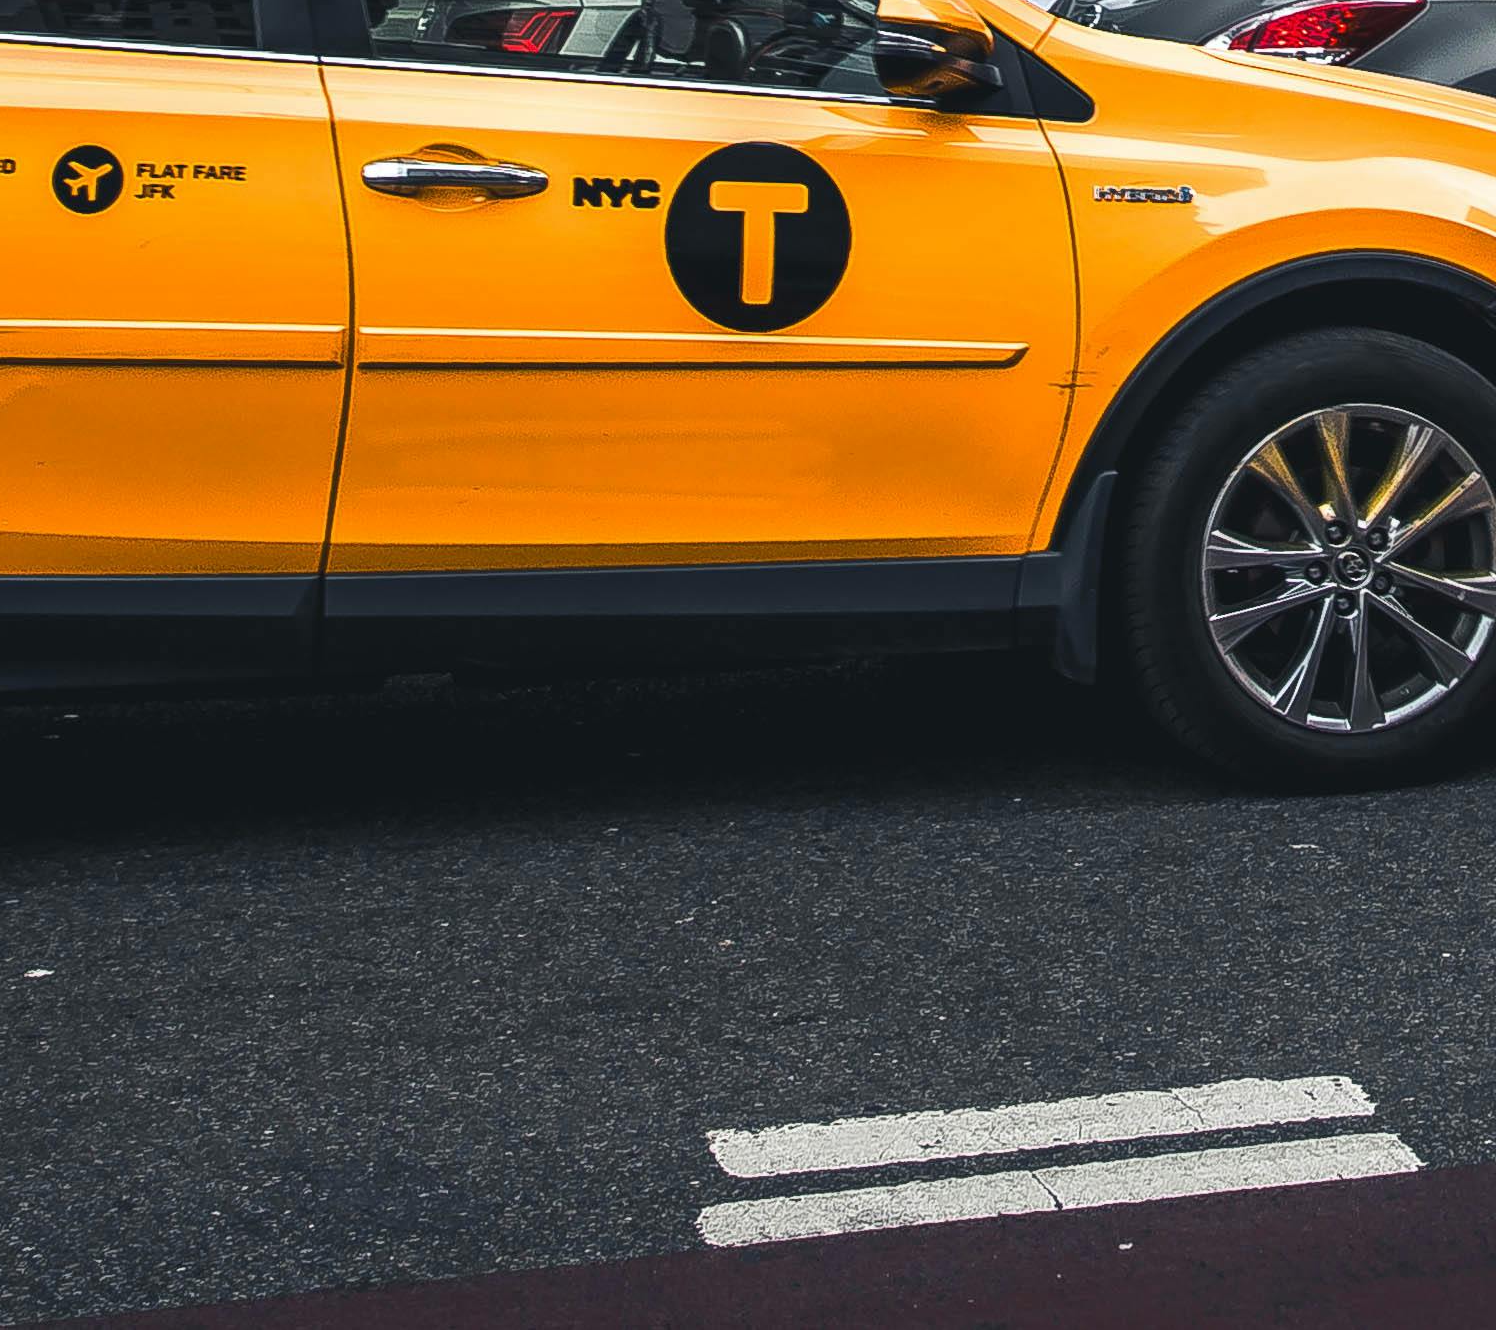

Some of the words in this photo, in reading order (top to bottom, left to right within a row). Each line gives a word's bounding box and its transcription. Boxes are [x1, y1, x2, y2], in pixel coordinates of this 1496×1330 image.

[135, 163, 189, 179] FLAT
[192, 164, 247, 181] FARE
[134, 183, 176, 199] JFK
[572, 177, 661, 209] NYC
[709, 180, 809, 305] T
